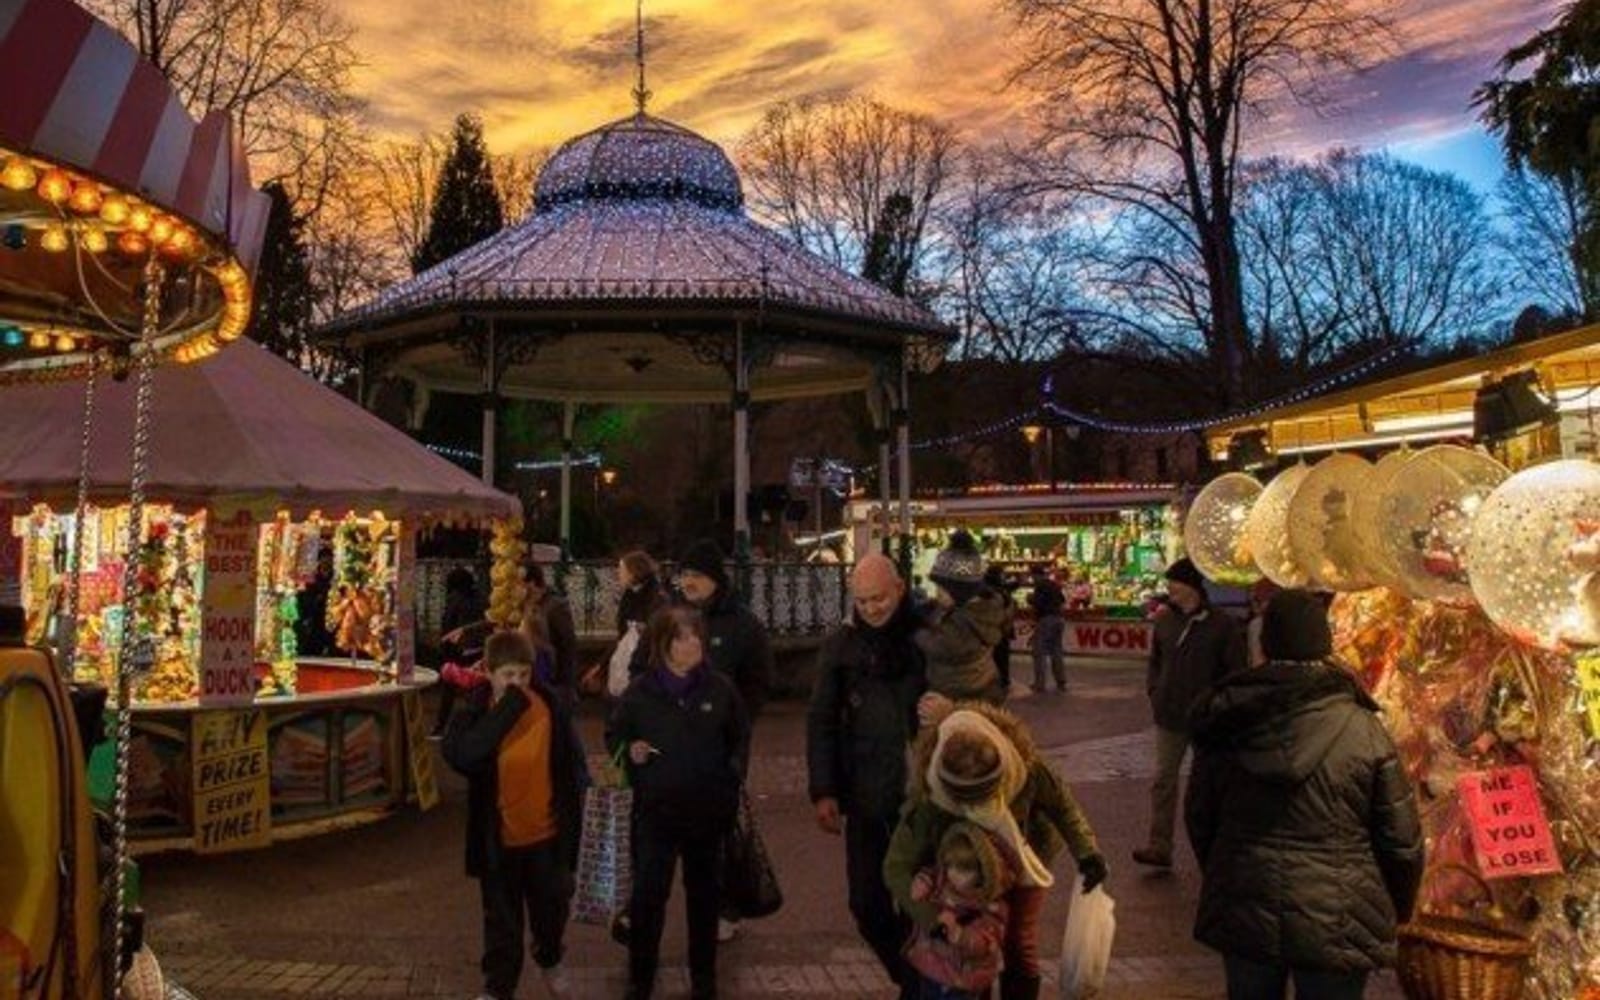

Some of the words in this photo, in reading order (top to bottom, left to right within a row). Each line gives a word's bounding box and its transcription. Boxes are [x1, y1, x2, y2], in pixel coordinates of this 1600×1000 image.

[214, 533, 248, 550] THE
[208, 556, 252, 573] BEST
[205, 617, 251, 641] HOOK
[1075, 627, 1149, 649] WON
[223, 647, 233, 661] A
[205, 668, 252, 695] DUCK
[199, 751, 263, 789] PRIZE
[1481, 774, 1514, 793] ME
[206, 786, 256, 815] EVERY
[1492, 801, 1513, 817] IF
[200, 808, 263, 848] TIME!
[1486, 823, 1536, 842] YOU
[1487, 847, 1550, 868] LOSE
